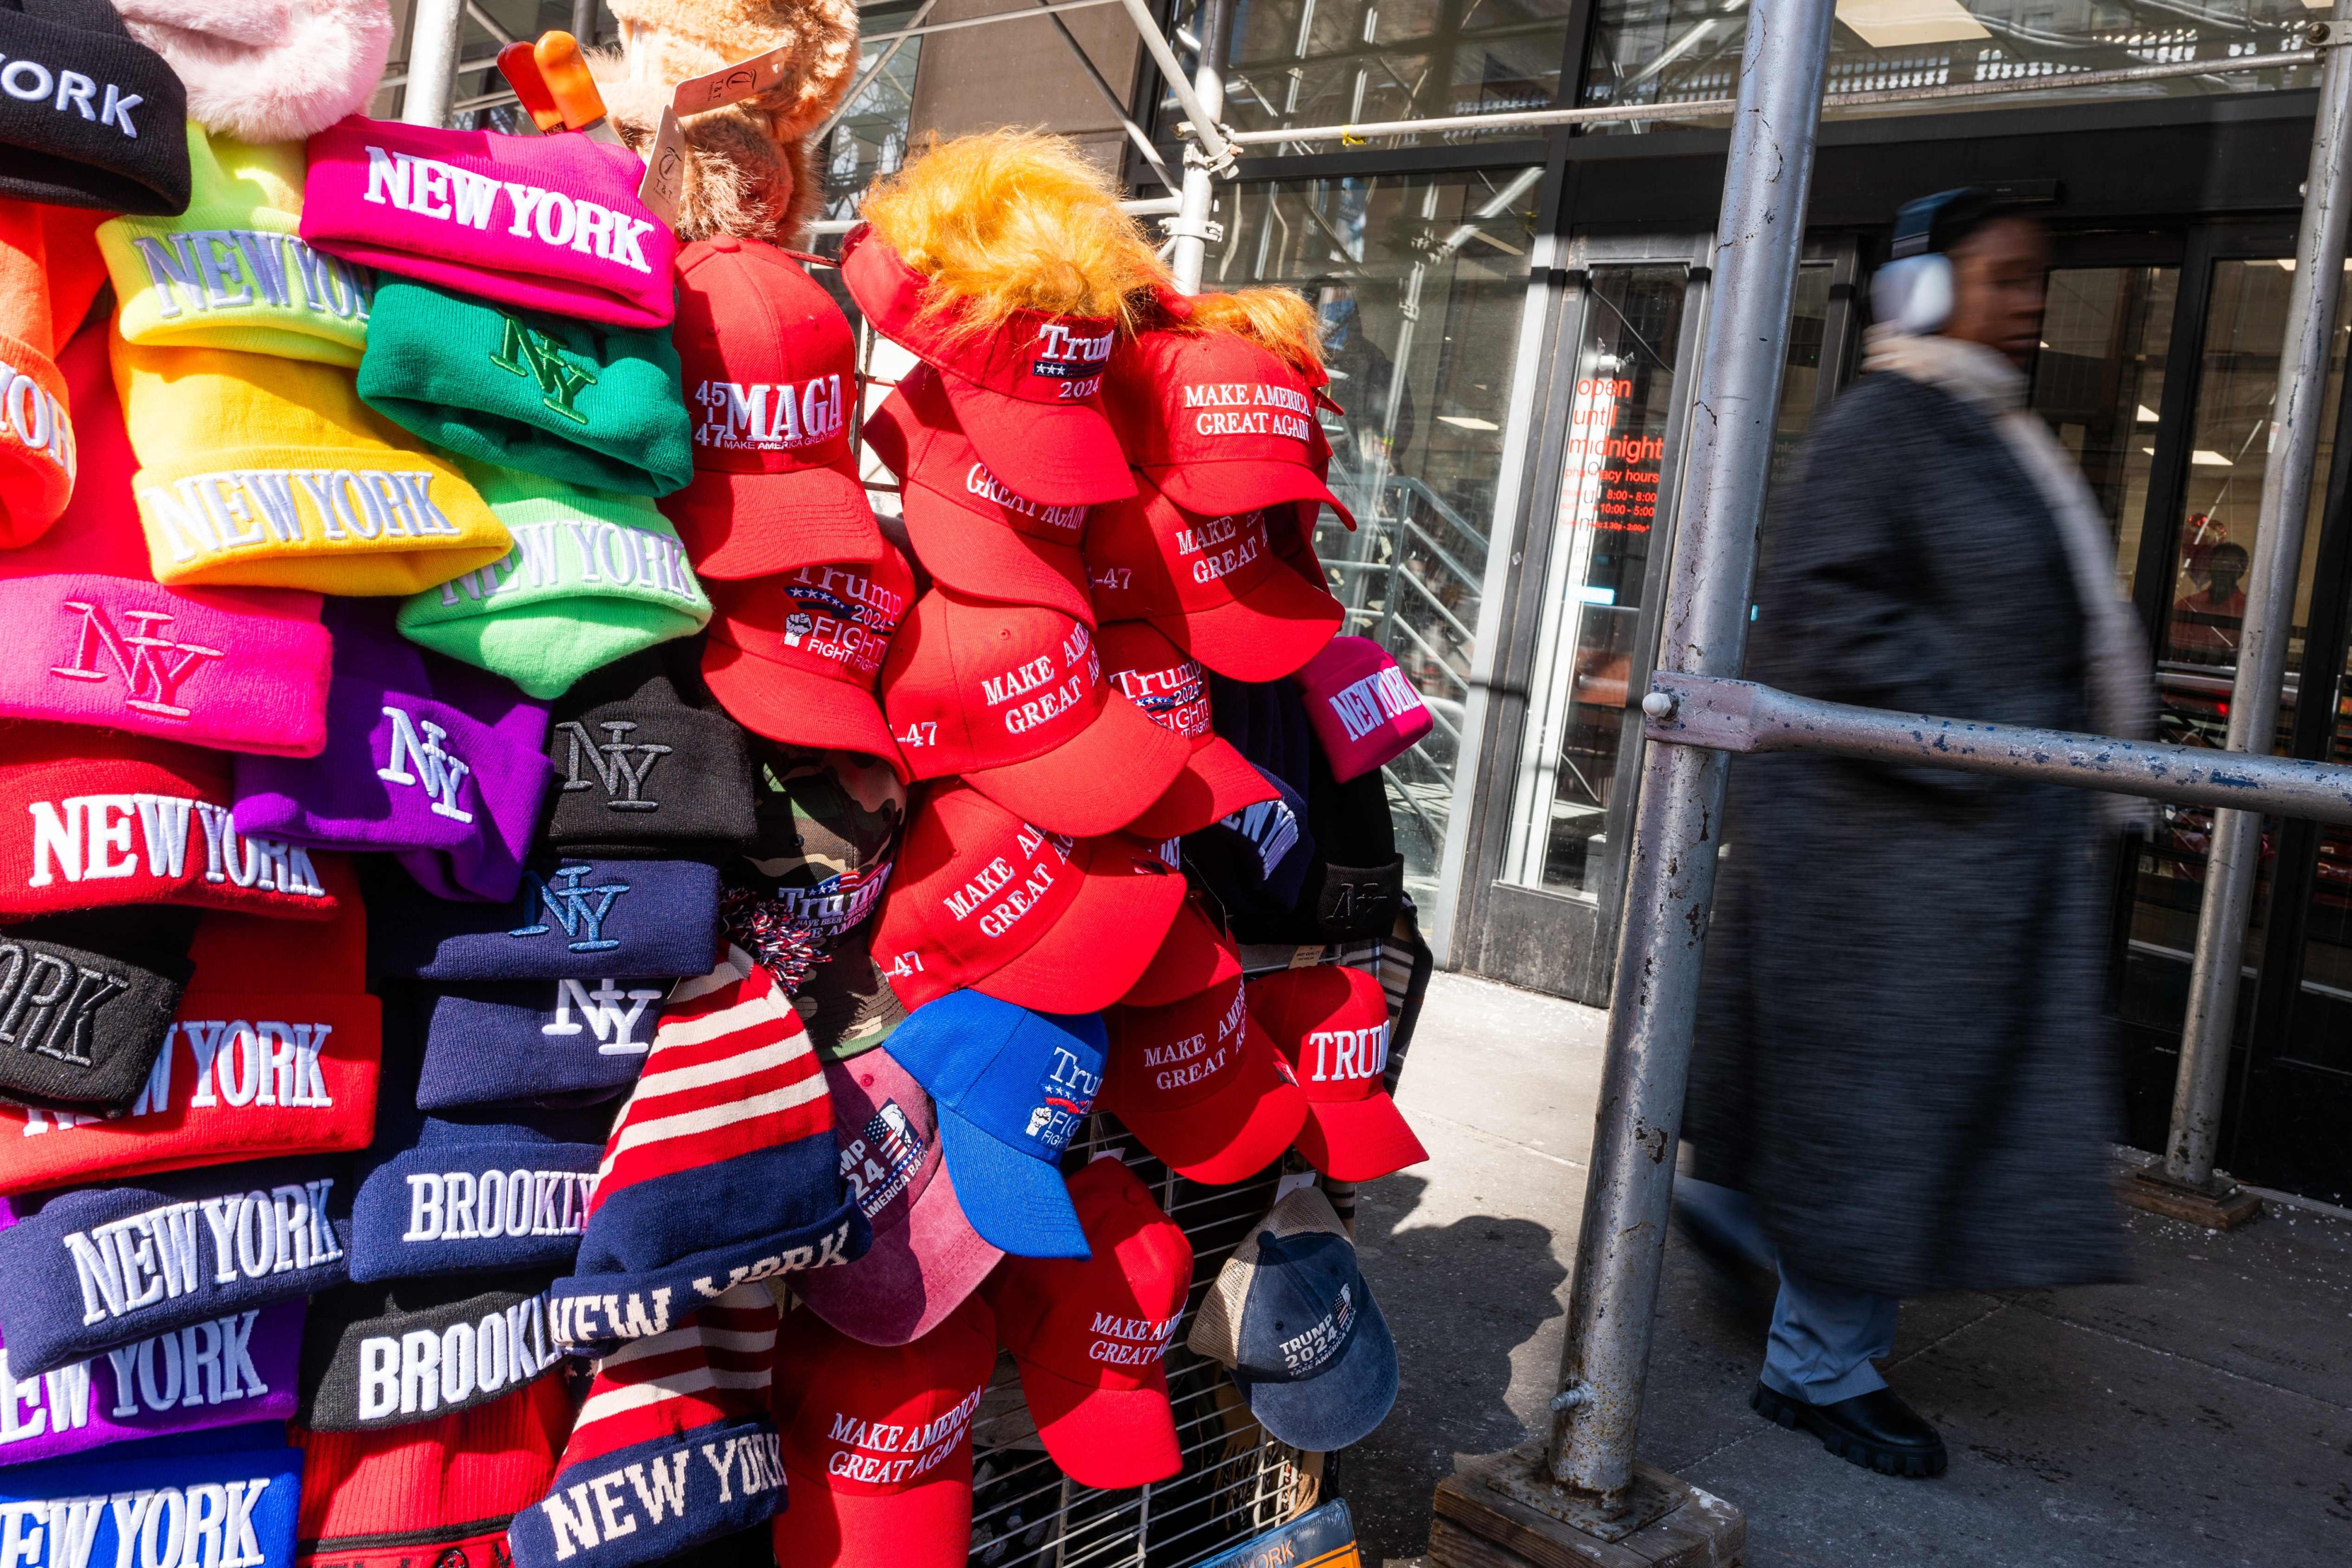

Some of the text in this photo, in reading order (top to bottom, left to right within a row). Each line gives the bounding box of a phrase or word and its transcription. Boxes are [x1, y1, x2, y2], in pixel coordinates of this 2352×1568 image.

[0, 53, 144, 138] ORK
[363, 145, 654, 273] NEW YORK
[133, 229, 291, 318] NEW
[490, 307, 598, 424] NY
[1058, 377, 1099, 398] 2024
[1577, 378, 1632, 399] open
[694, 380, 727, 407] 45
[722, 374, 843, 442] MAGA
[1184, 384, 1311, 416] MAKE AMERICA
[1574, 404, 1618, 427] until
[694, 423, 726, 448] 47
[724, 439, 756, 450] MAKE
[757, 438, 803, 450] AMERICA
[1196, 412, 1310, 441] GREAT AGAIN
[1569, 434, 1664, 465] midnight
[1606, 489, 1628, 501] 8:00
[1635, 492, 1657, 503] 8:00
[1625, 468, 1660, 484] hours
[140, 468, 461, 562] NEW YORK
[1175, 515, 1237, 556] MAKE
[1600, 503, 1625, 515] 10:00
[1633, 505, 1655, 517] 5:00
[563, 519, 697, 601] YORK
[1193, 535, 1258, 584] GREAT
[851, 604, 886, 632] 2024
[51, 601, 225, 720] NY
[981, 655, 1055, 706] MAKE
[1109, 658, 1204, 700] Trump
[1005, 674, 1083, 735] GREAT
[1173, 684, 1199, 706] 2024
[1328, 678, 1385, 743] NEW
[377, 706, 474, 824] NY
[555, 721, 673, 813] NY
[29, 794, 194, 888] NEW
[508, 865, 631, 953] NY
[943, 856, 1016, 922] MAKE
[979, 862, 1055, 939] GREAT
[542, 979, 662, 1056] NY
[182, 1019, 333, 1109] YORK
[1144, 1033, 1207, 1068] MAKE
[1156, 1047, 1226, 1090] GREAT
[63, 1178, 343, 1322] NEW YORK
[1089, 1312, 1151, 1341] MAKE
[1279, 1314, 1333, 1355] TRUMP
[1285, 1326, 1338, 1369] 2024
[109, 1308, 268, 1418] YORK
[1089, 1340, 1157, 1365] GREAT
[1289, 1364, 1314, 1376] TAKE
[1315, 1332, 1346, 1367] AMERICA
[828, 1385, 981, 1453] MAKE AMERICA
[828, 1419, 971, 1483] GREAT AGAIN
[0, 1477, 270, 1568] EW YORK
[542, 1433, 787, 1561] NEW YORK
